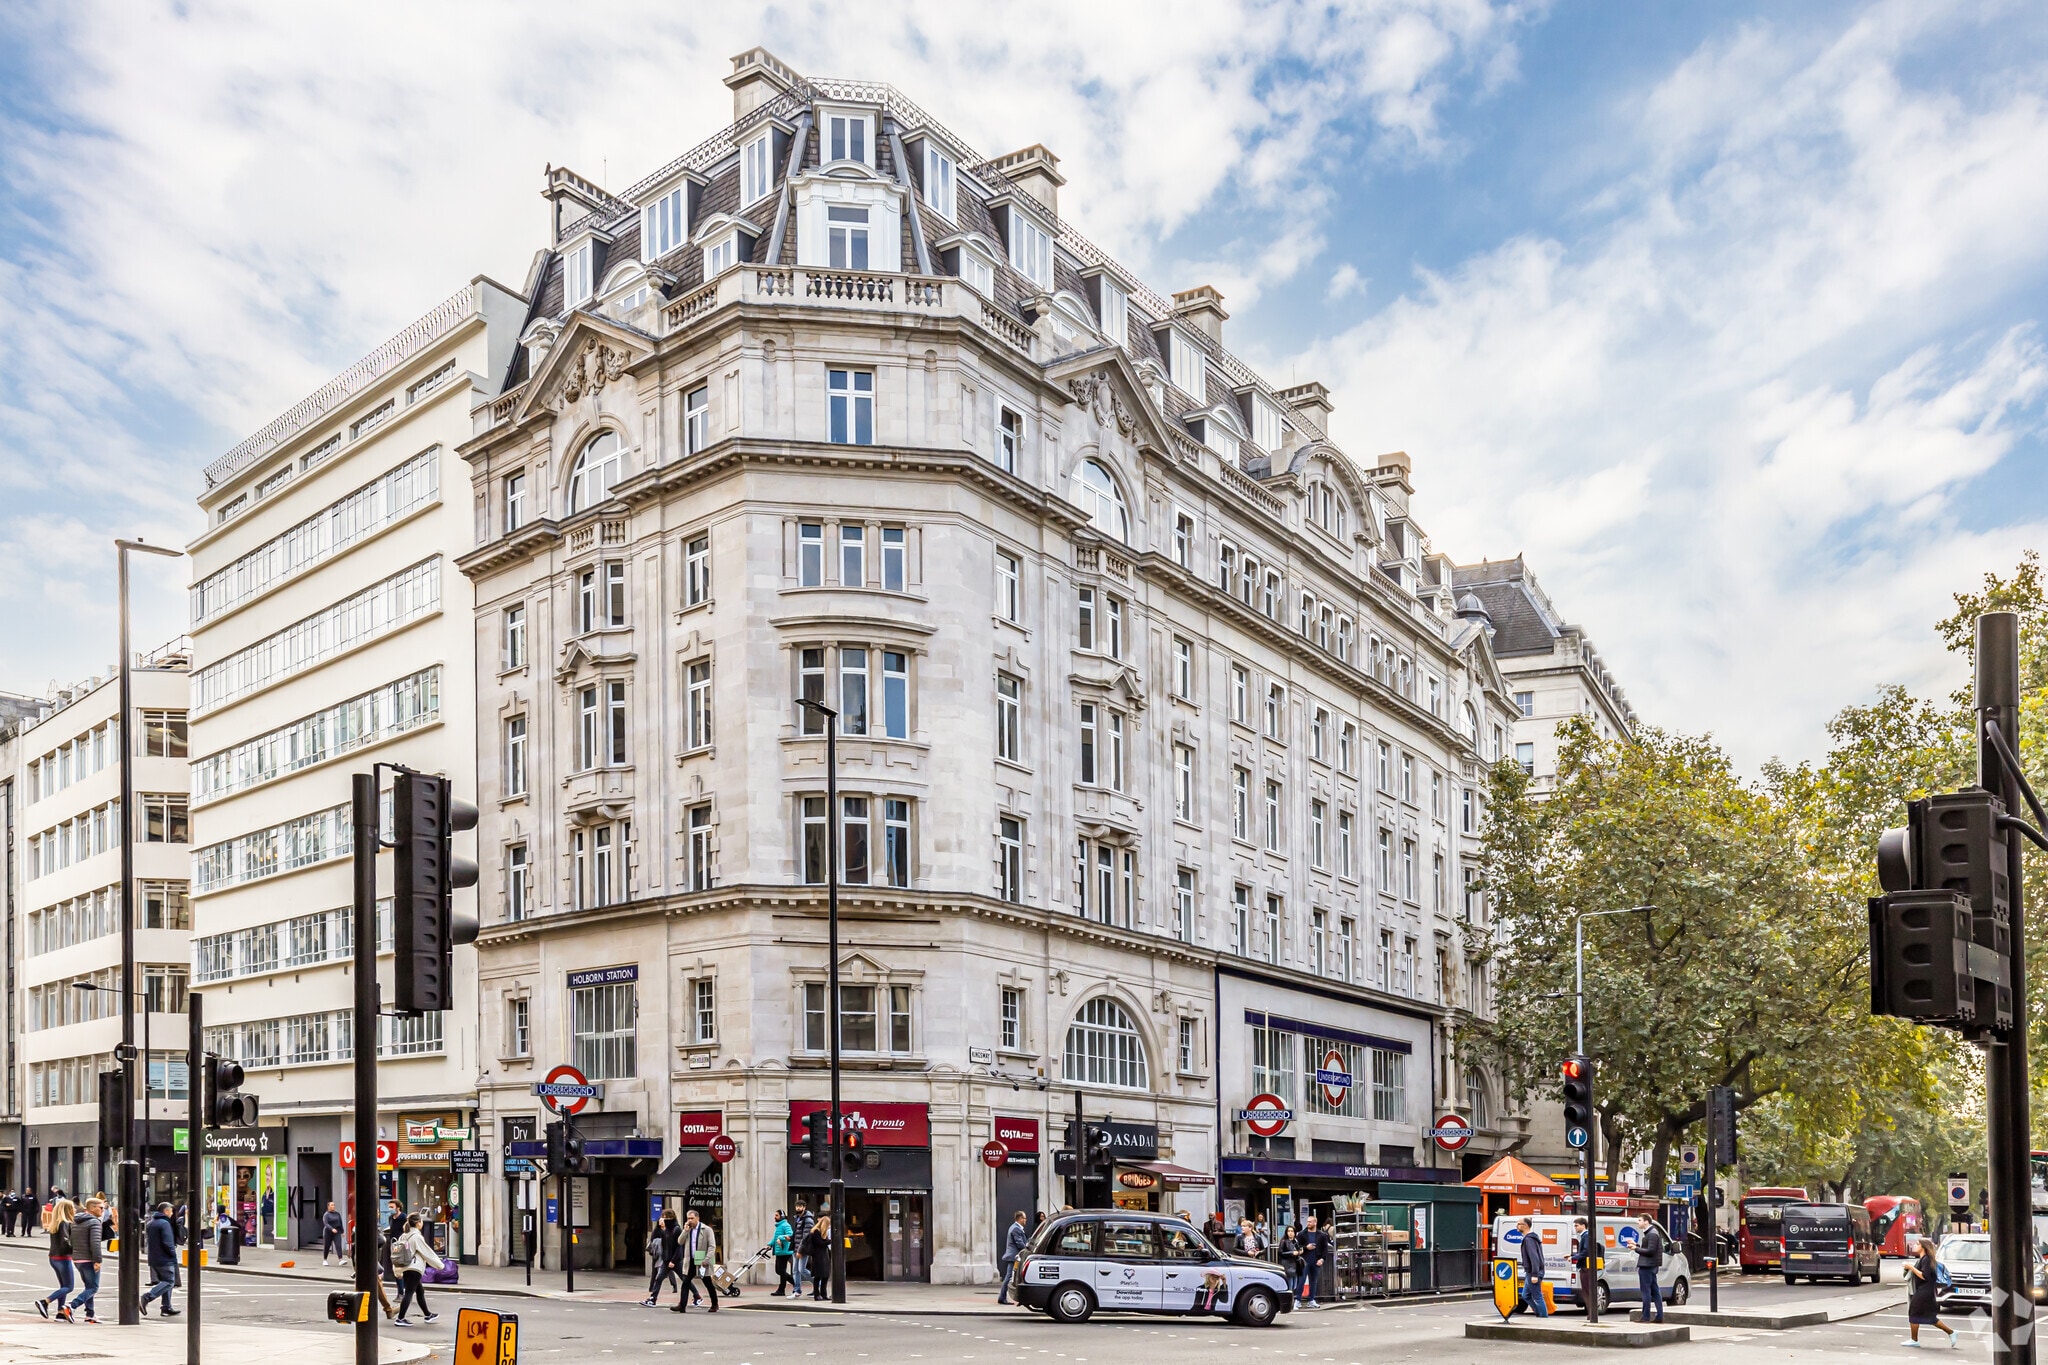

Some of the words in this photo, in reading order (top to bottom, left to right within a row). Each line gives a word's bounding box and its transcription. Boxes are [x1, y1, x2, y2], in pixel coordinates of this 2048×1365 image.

[572, 972, 604, 985] HOLBORN
[606, 968, 633, 981] STATION
[1318, 1070, 1351, 1086] UNDERGROUND
[538, 1083, 594, 1096] UNDERGROUND
[1241, 1110, 1291, 1120] UNDERGROUND
[683, 1125, 705, 1134] COSTA
[871, 1118, 905, 1130] pronto
[513, 1125, 528, 1140] Dry
[1000, 1129, 1021, 1139] COSTA
[1430, 1128, 1472, 1137] UNDERGROUND
[205, 1132, 257, 1152] Superdrug
[1113, 1132, 1155, 1148] ASADAL
[1344, 1166, 1369, 1177] HOLBORN
[1369, 1167, 1389, 1177] STATION
[1123, 1173, 1151, 1187] BRIDGES
[467, 1320, 489, 1340] LOVE
